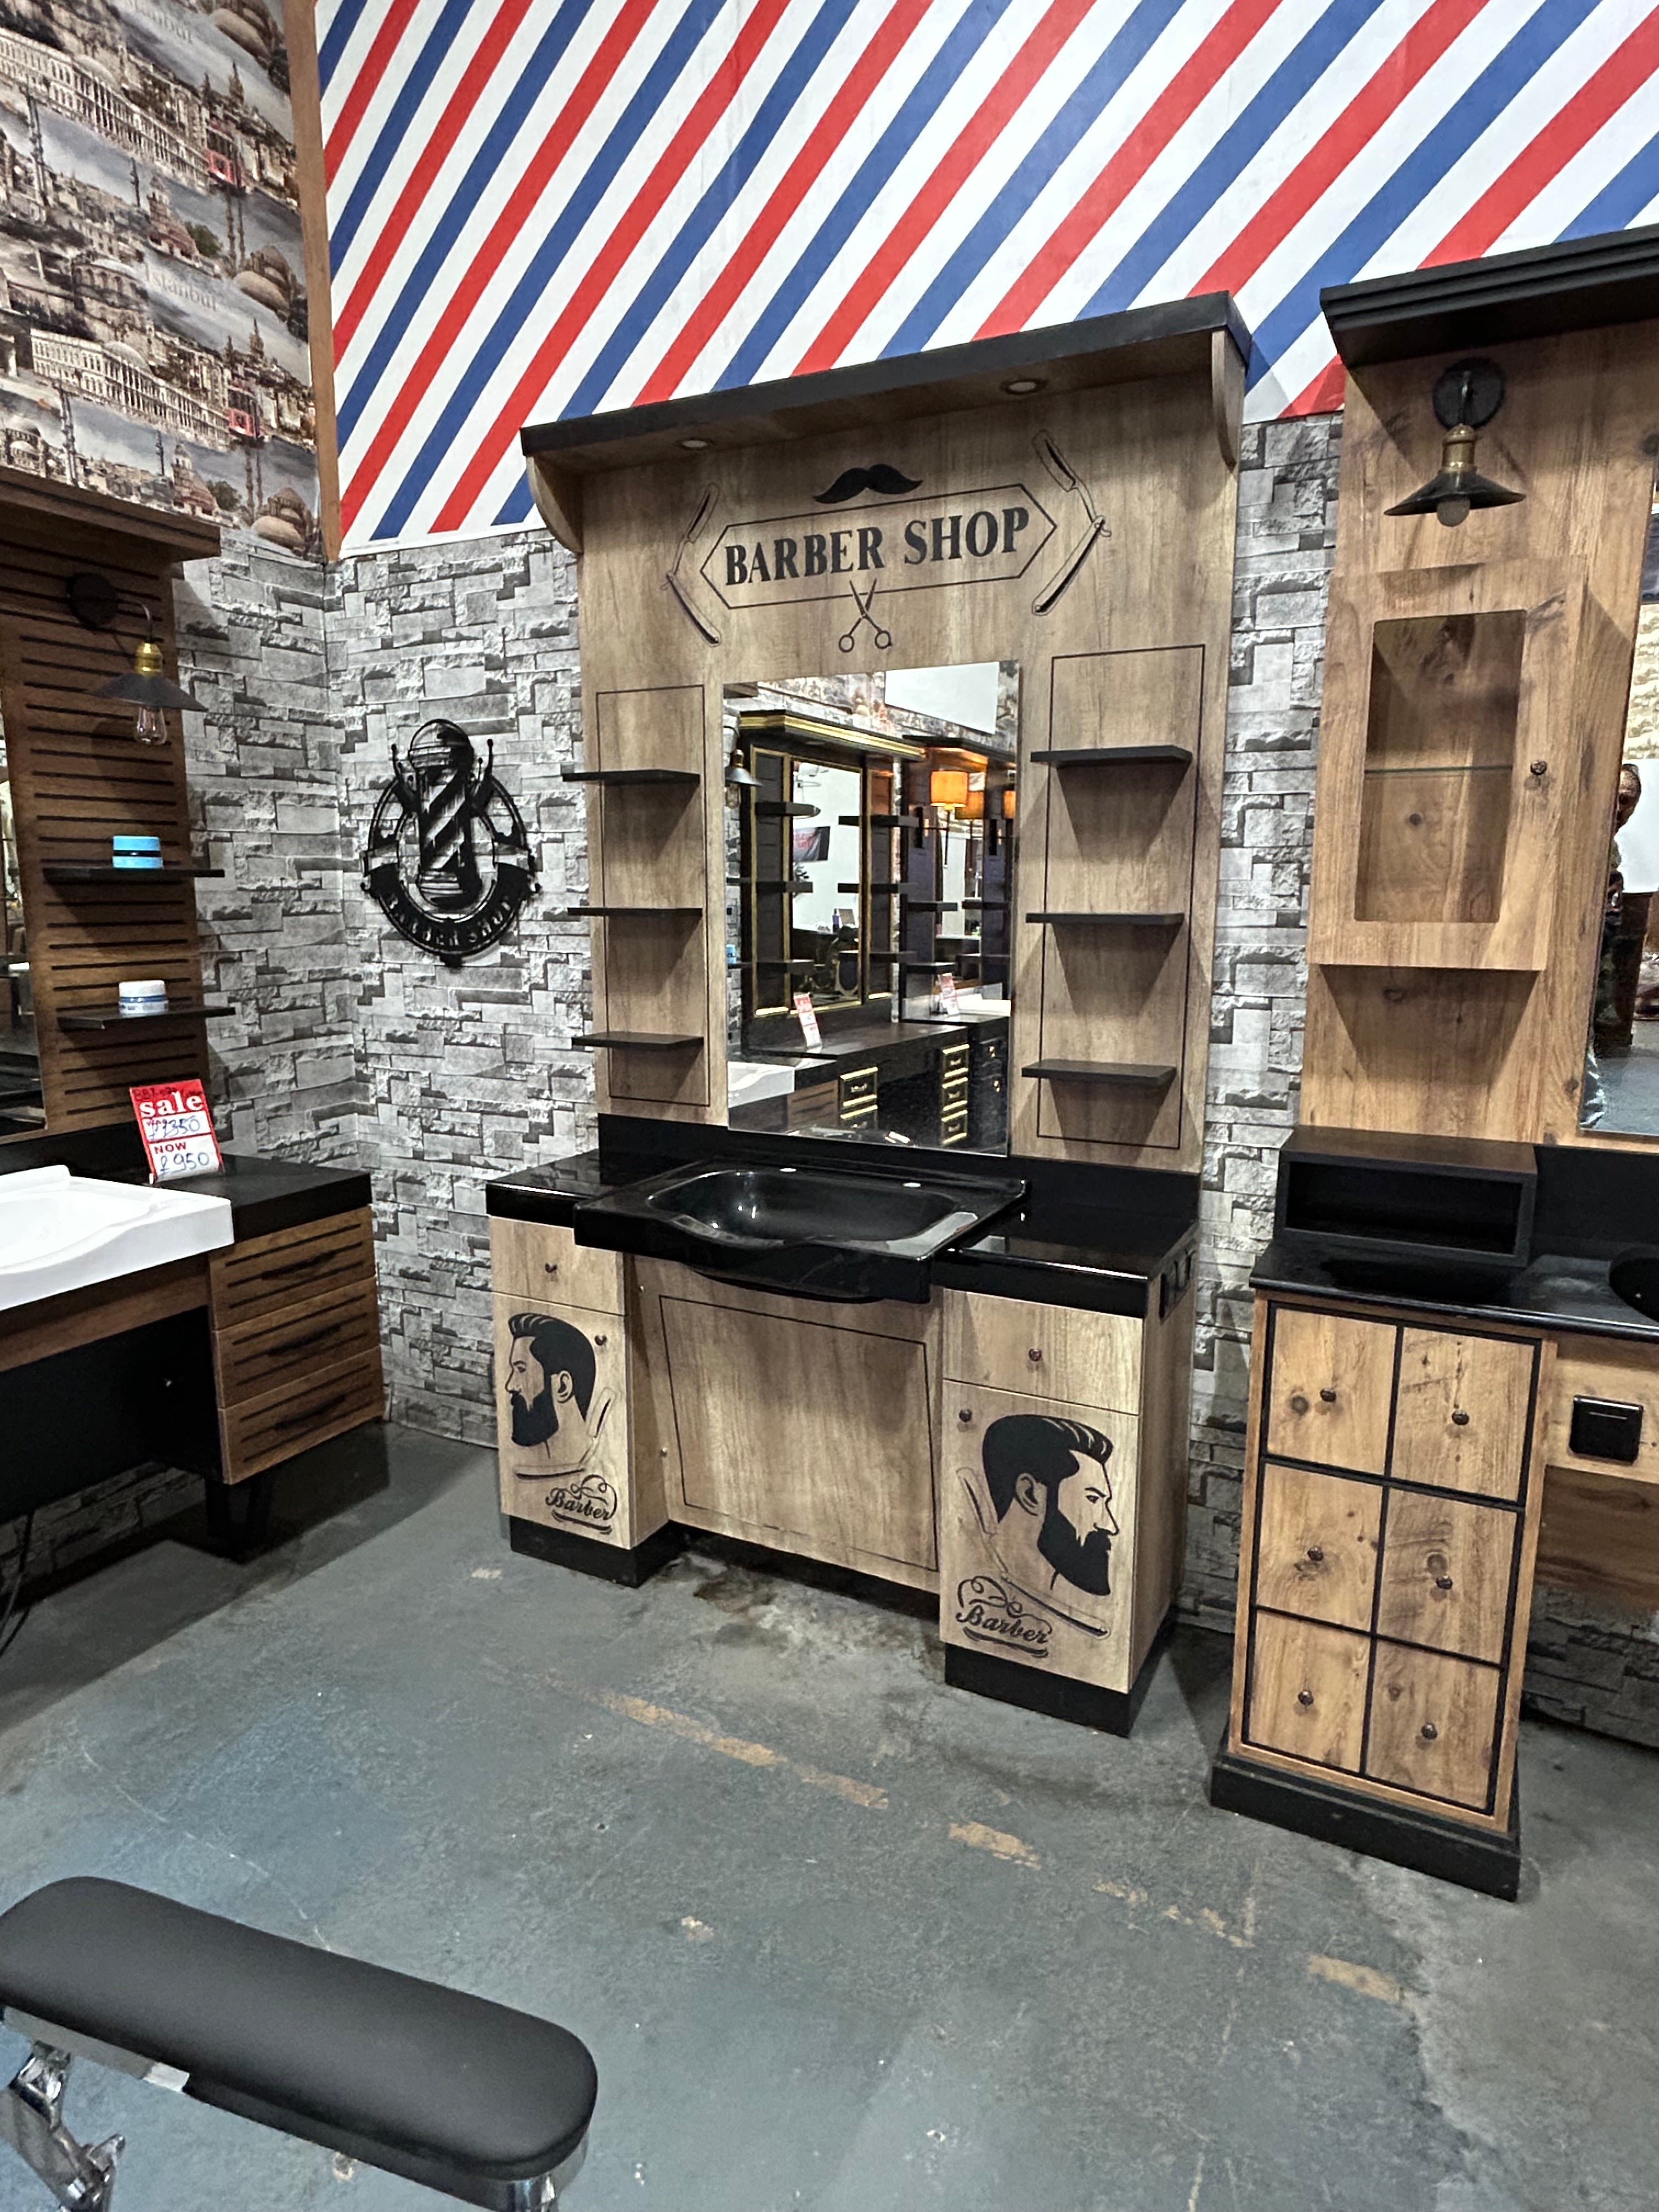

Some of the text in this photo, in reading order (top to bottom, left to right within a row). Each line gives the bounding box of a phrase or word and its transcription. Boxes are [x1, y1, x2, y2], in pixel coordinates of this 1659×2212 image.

[725, 506, 1030, 586] BARBER SHOP
[139, 1091, 204, 1119] sale
[154, 1141, 187, 1154] NOW
[160, 1152, 210, 1175] £950
[545, 1484, 616, 1521] Barber
[956, 1600, 1050, 1644] Barber
